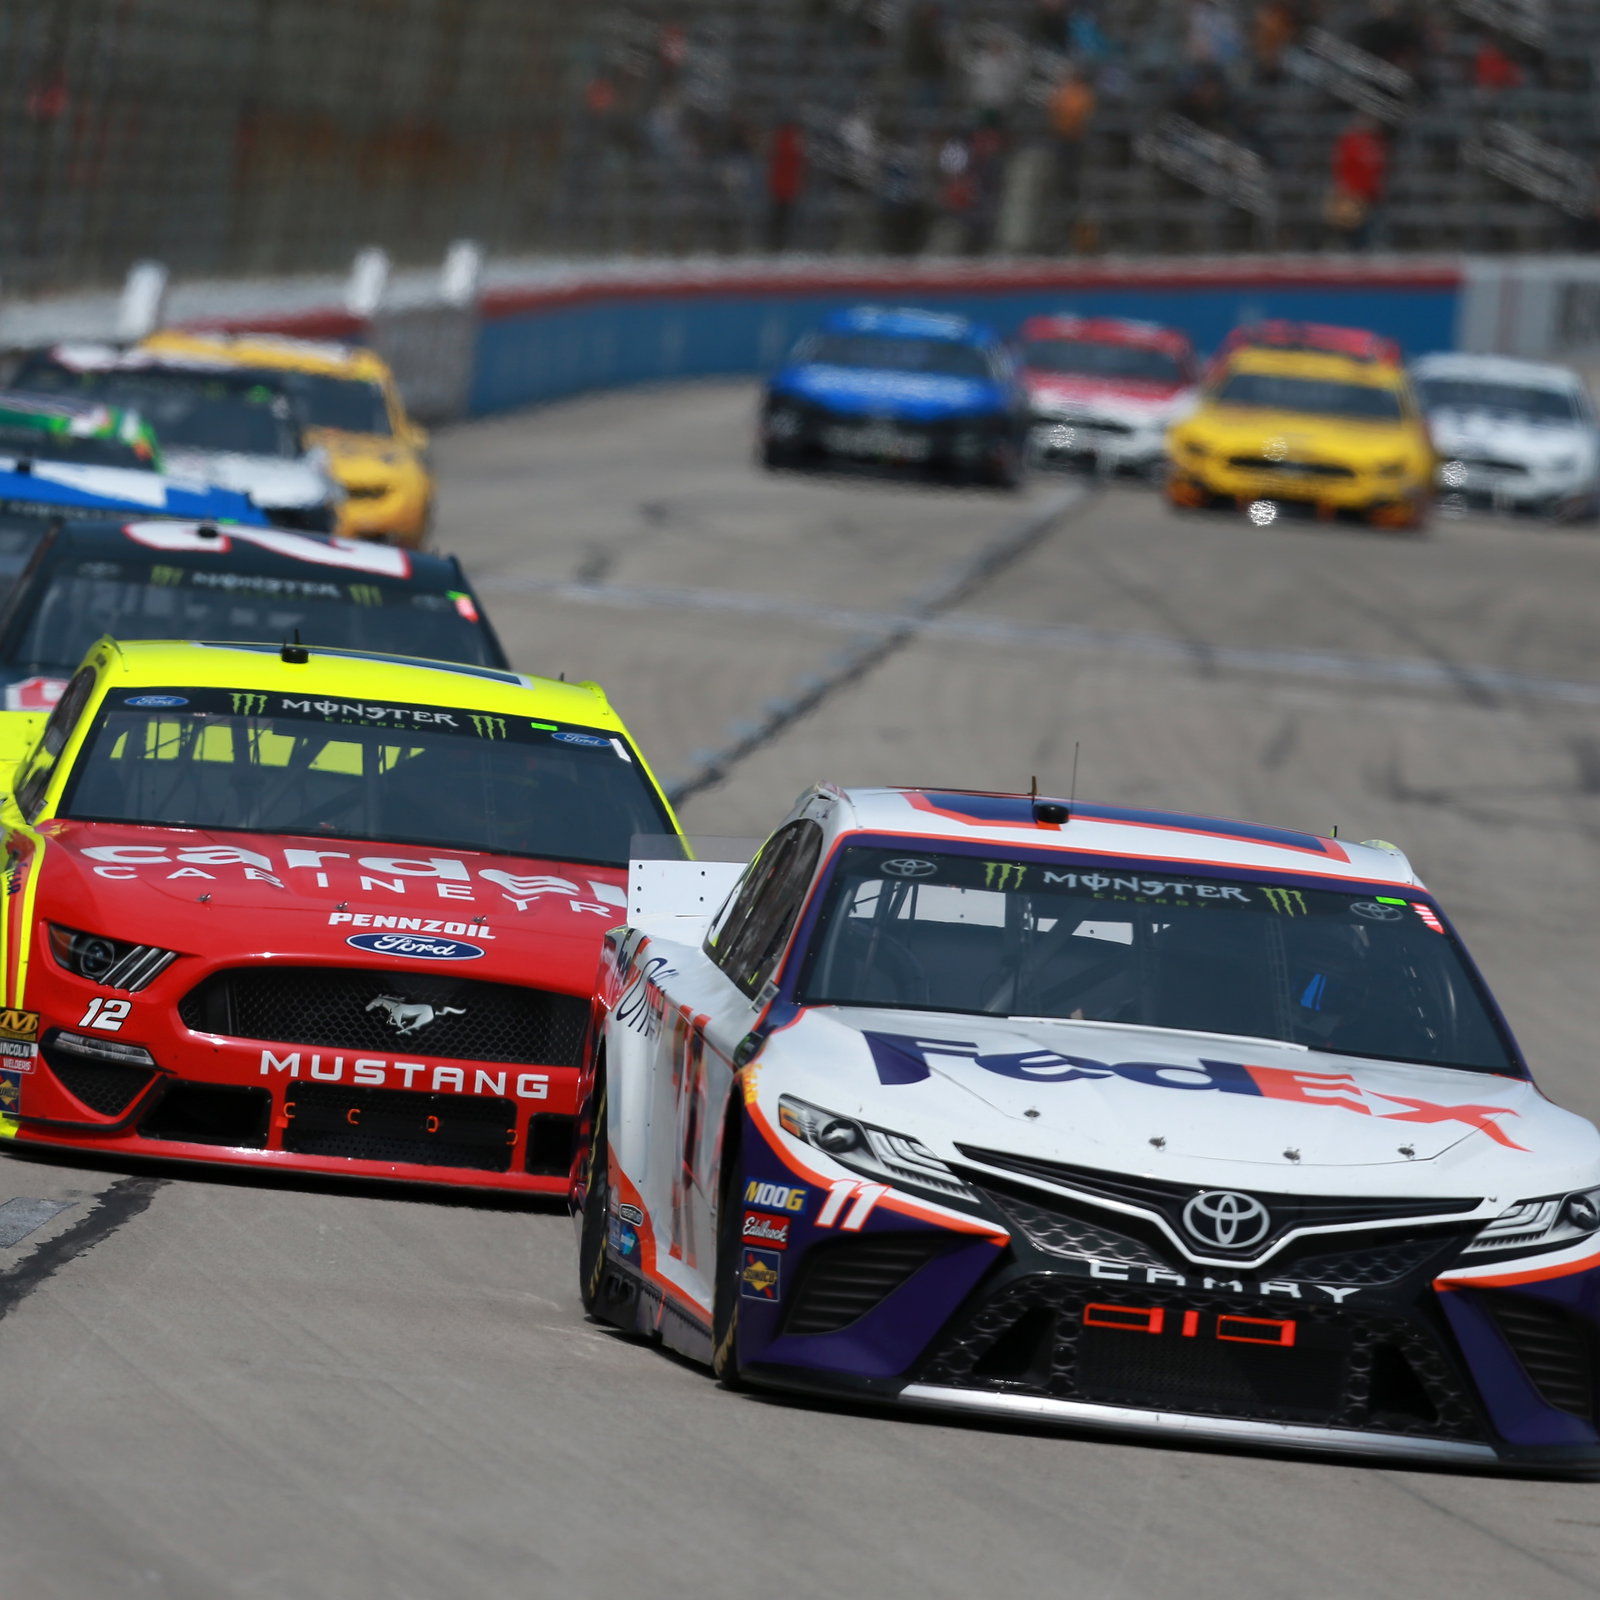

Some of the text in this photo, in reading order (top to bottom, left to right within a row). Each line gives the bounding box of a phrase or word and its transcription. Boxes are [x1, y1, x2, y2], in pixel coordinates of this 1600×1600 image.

[282, 699, 460, 727] MONSTER
[324, 716, 421, 730] ENERGY
[80, 845, 628, 908] cardel
[1044, 871, 1251, 902] MONSTER
[1093, 892, 1208, 909] ENERGY
[328, 912, 496, 939] PENNZOIL
[374, 934, 456, 957] Ford
[78, 997, 132, 1031] 12
[0, 1042, 31, 1058] INCOLN
[260, 1050, 549, 1099] MUSTANG
[862, 1029, 1535, 1153] FedEx
[744, 1181, 807, 1211] MOOG
[813, 1178, 893, 1232] 11
[1089, 1260, 1361, 1303] CAMRY
